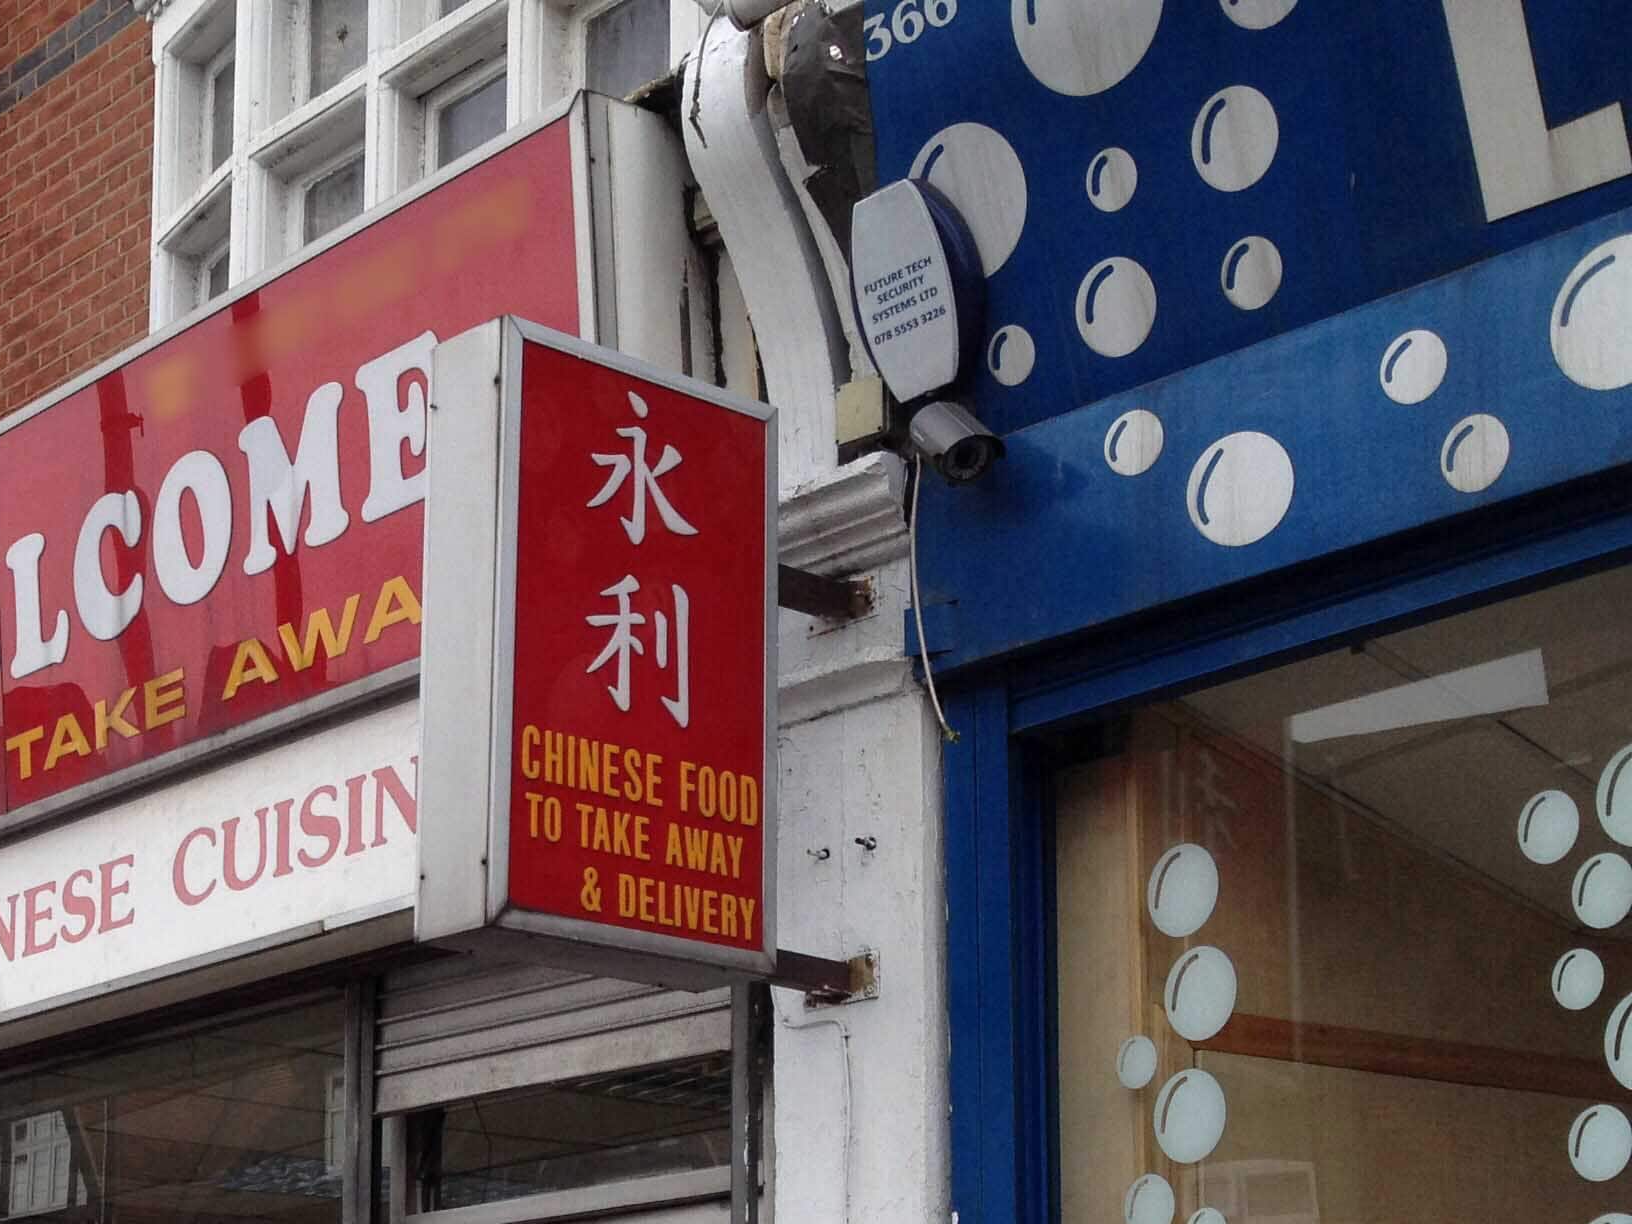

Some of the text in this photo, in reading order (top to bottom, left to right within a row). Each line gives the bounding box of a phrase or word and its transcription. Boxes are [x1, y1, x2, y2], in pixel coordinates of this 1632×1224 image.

[863, 0, 958, 61] 366
[1442, 0, 1632, 223] L
[864, 255, 932, 296] FUTURE TECH
[872, 286, 938, 325] SYSTEMS LTD
[877, 275, 925, 305] SECURITY
[874, 305, 947, 346] 078 5553 3226
[586, 391, 699, 729] 永利
[6, 669, 187, 780] TAKE
[521, 724, 759, 827] CHINESE FOOD
[525, 792, 744, 879] TO TAKE AWAY
[580, 866, 757, 941] & DELIVERY
